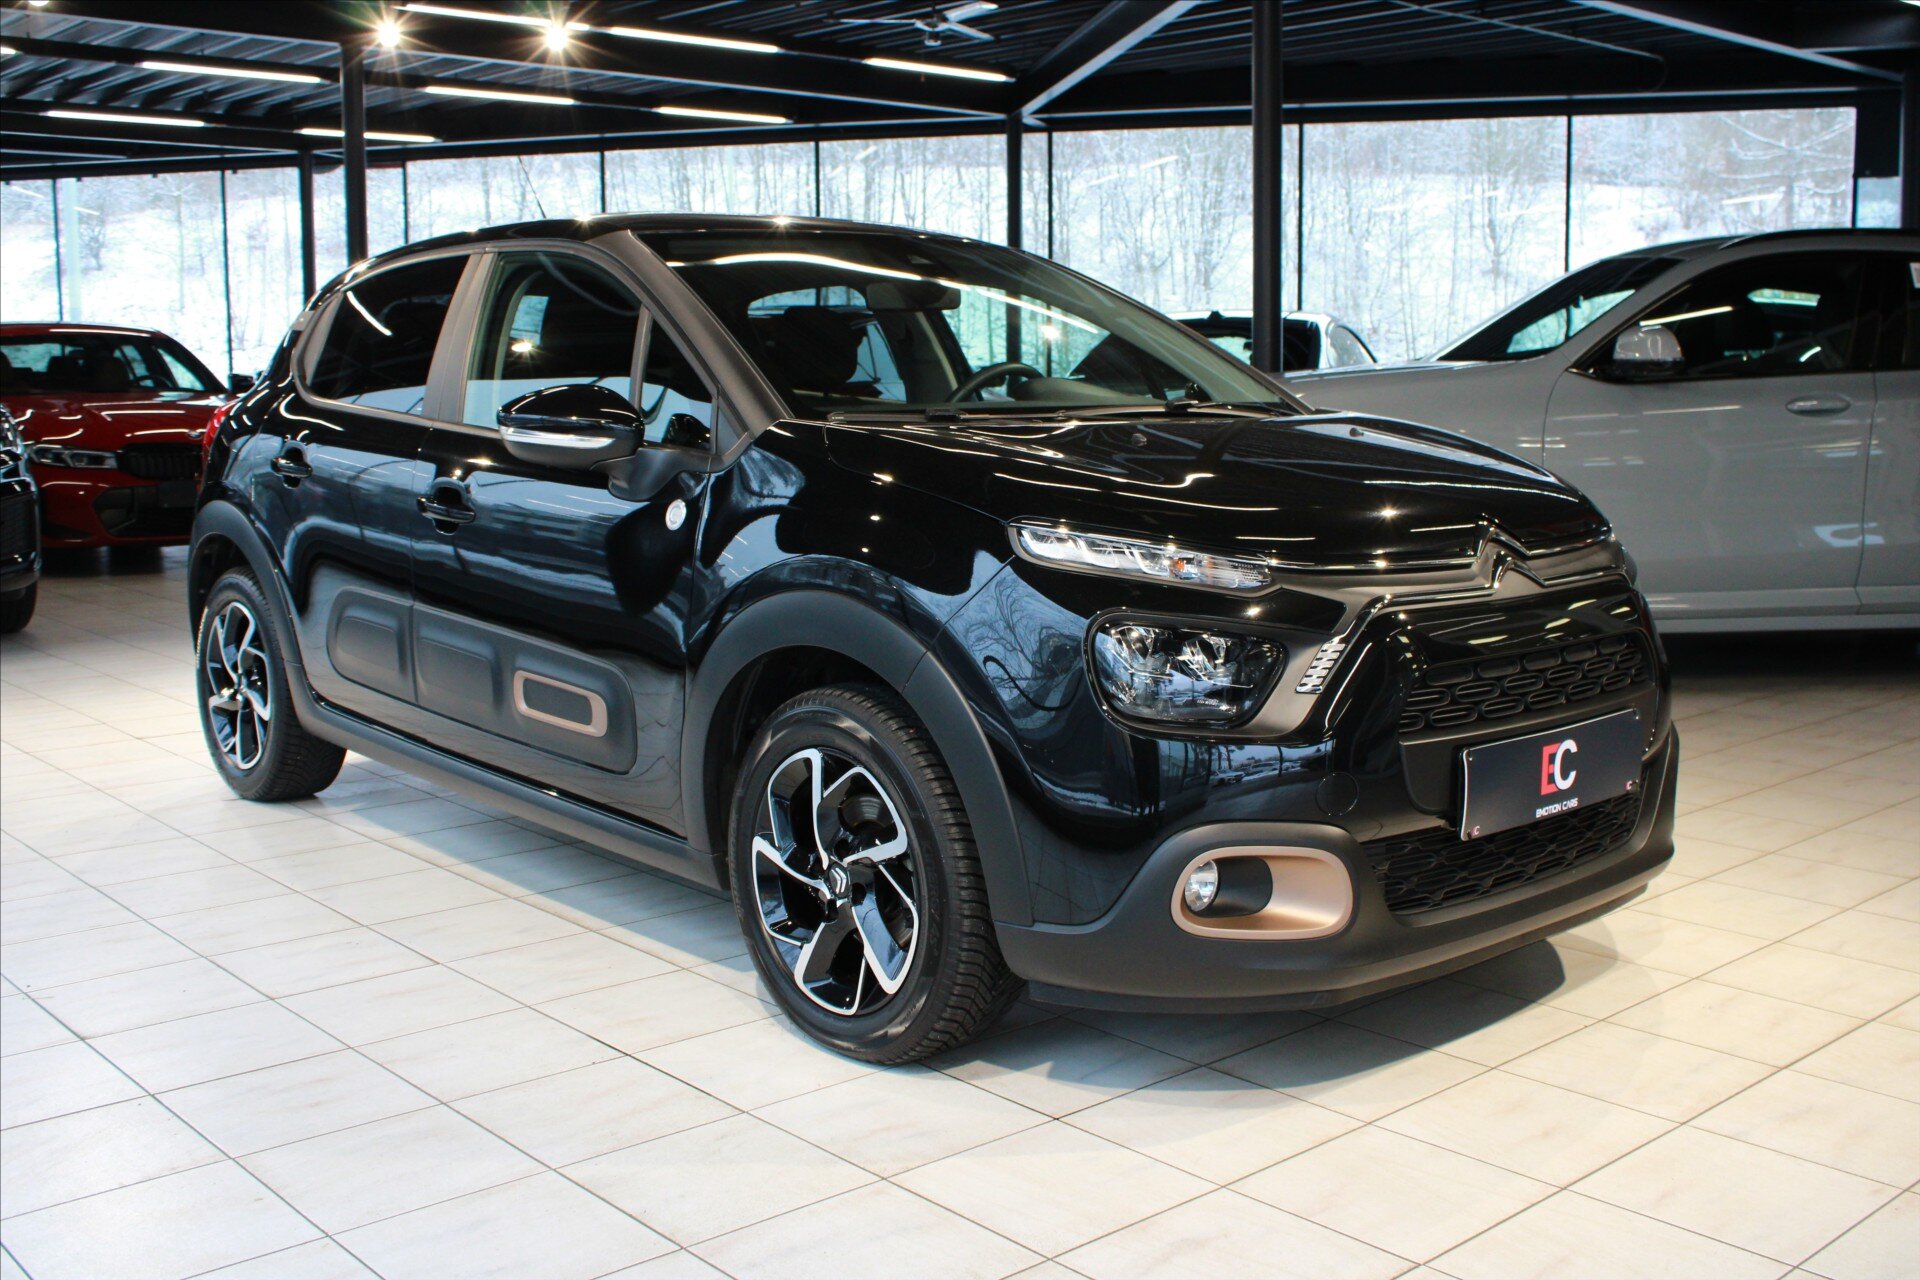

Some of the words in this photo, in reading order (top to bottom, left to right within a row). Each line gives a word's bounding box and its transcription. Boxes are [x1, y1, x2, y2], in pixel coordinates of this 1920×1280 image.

[1541, 739, 1578, 795] EC
[1536, 803, 1561, 818] EMOTION
[1562, 798, 1579, 811] CARS
